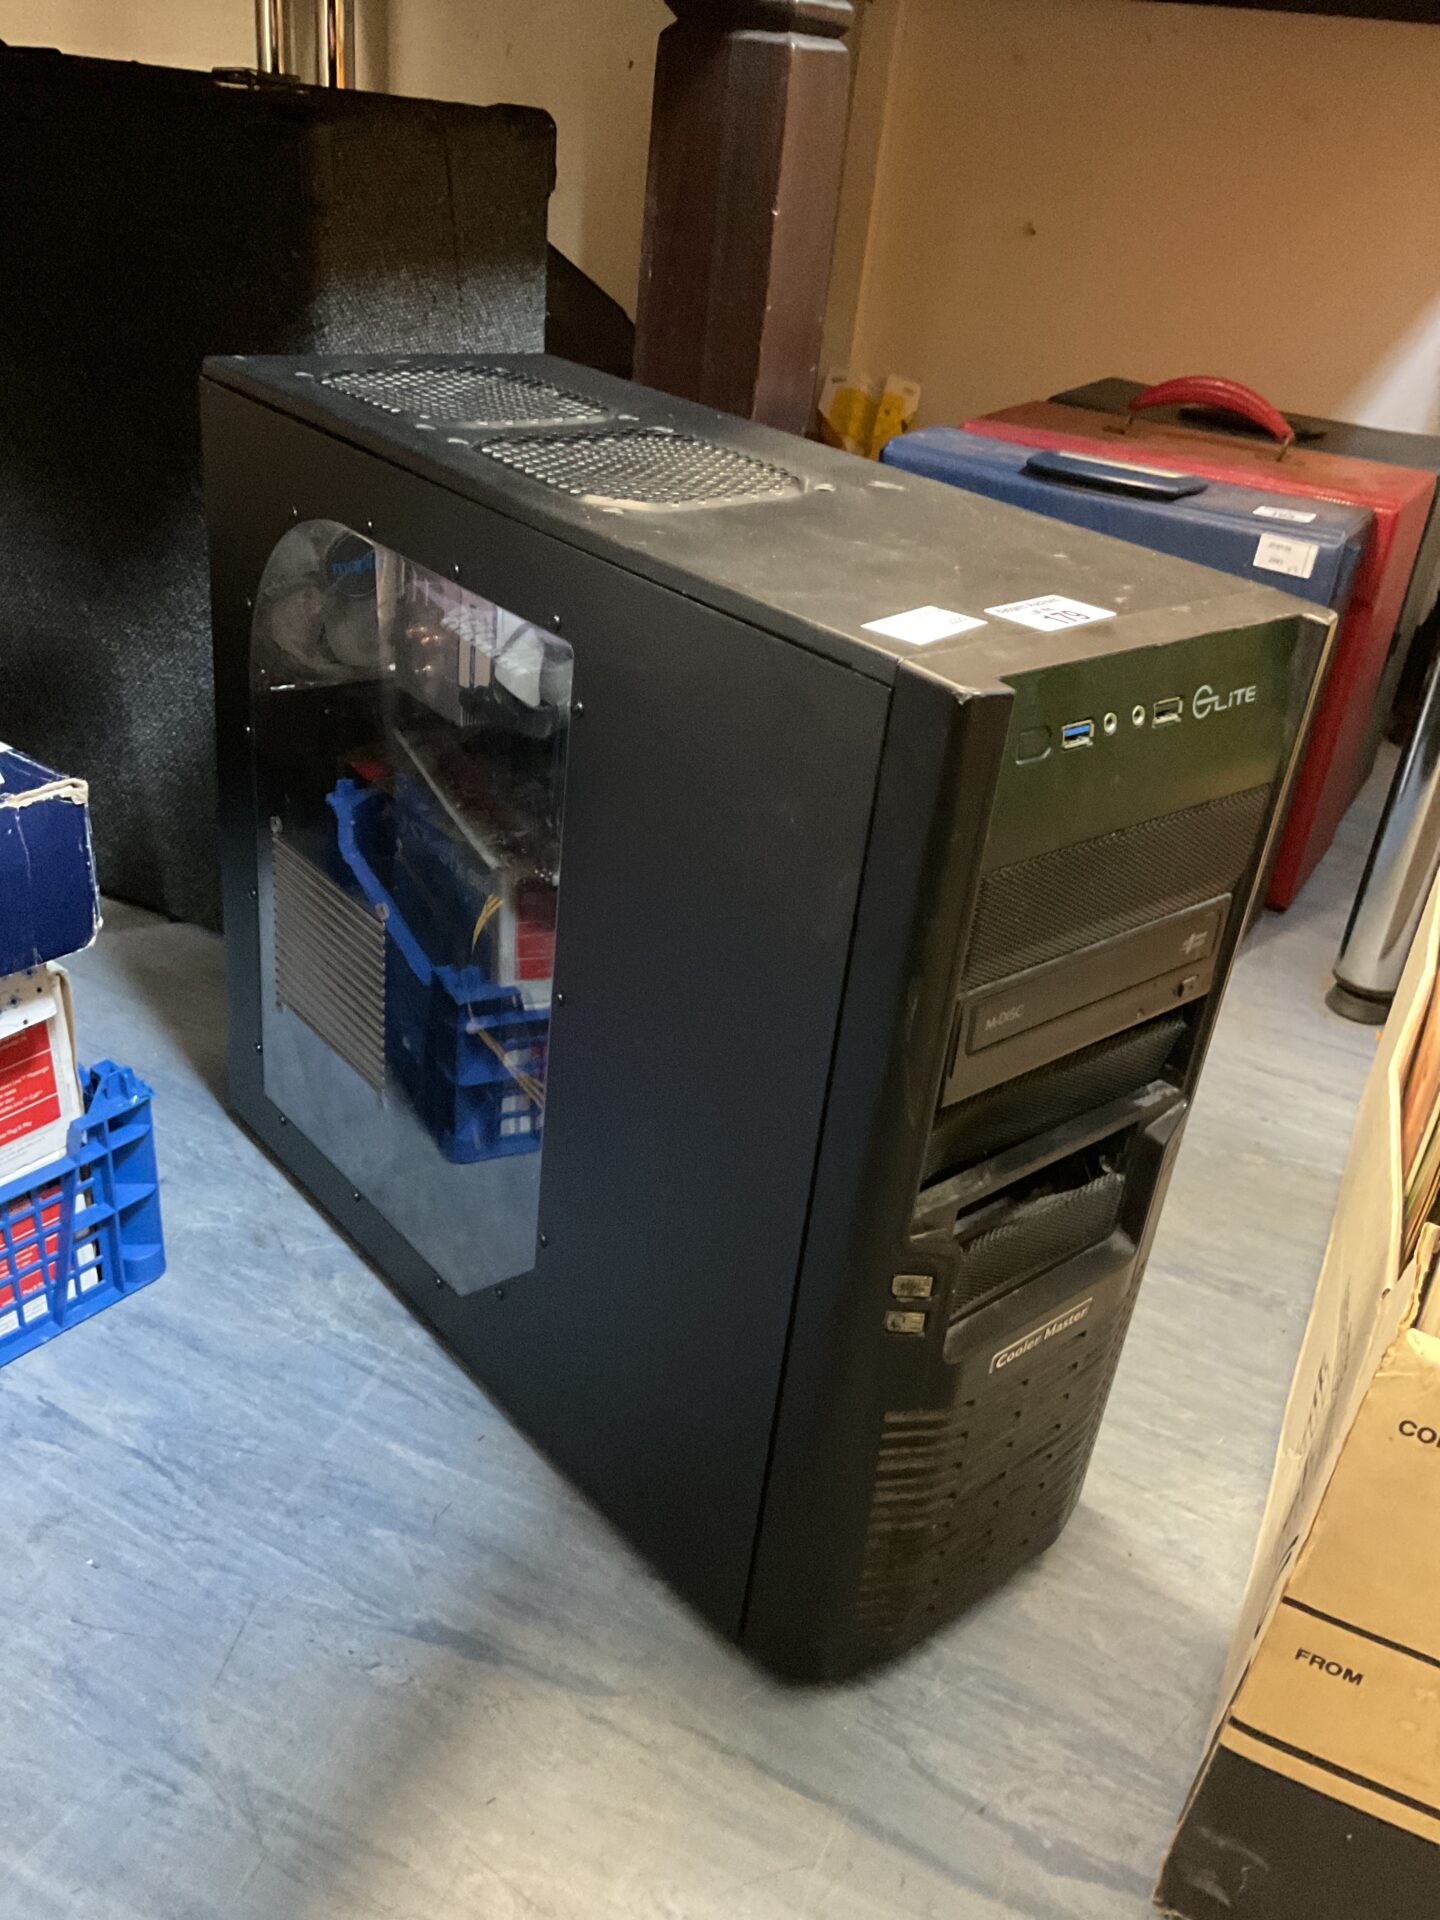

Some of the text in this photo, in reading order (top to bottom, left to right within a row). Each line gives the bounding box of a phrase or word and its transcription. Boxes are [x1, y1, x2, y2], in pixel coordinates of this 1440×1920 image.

[1044, 610, 1091, 624] 179
[996, 1307, 1088, 1369] Cooler Master
[1398, 1419, 1440, 1448] CO
[1295, 1648, 1364, 1686] FROM
